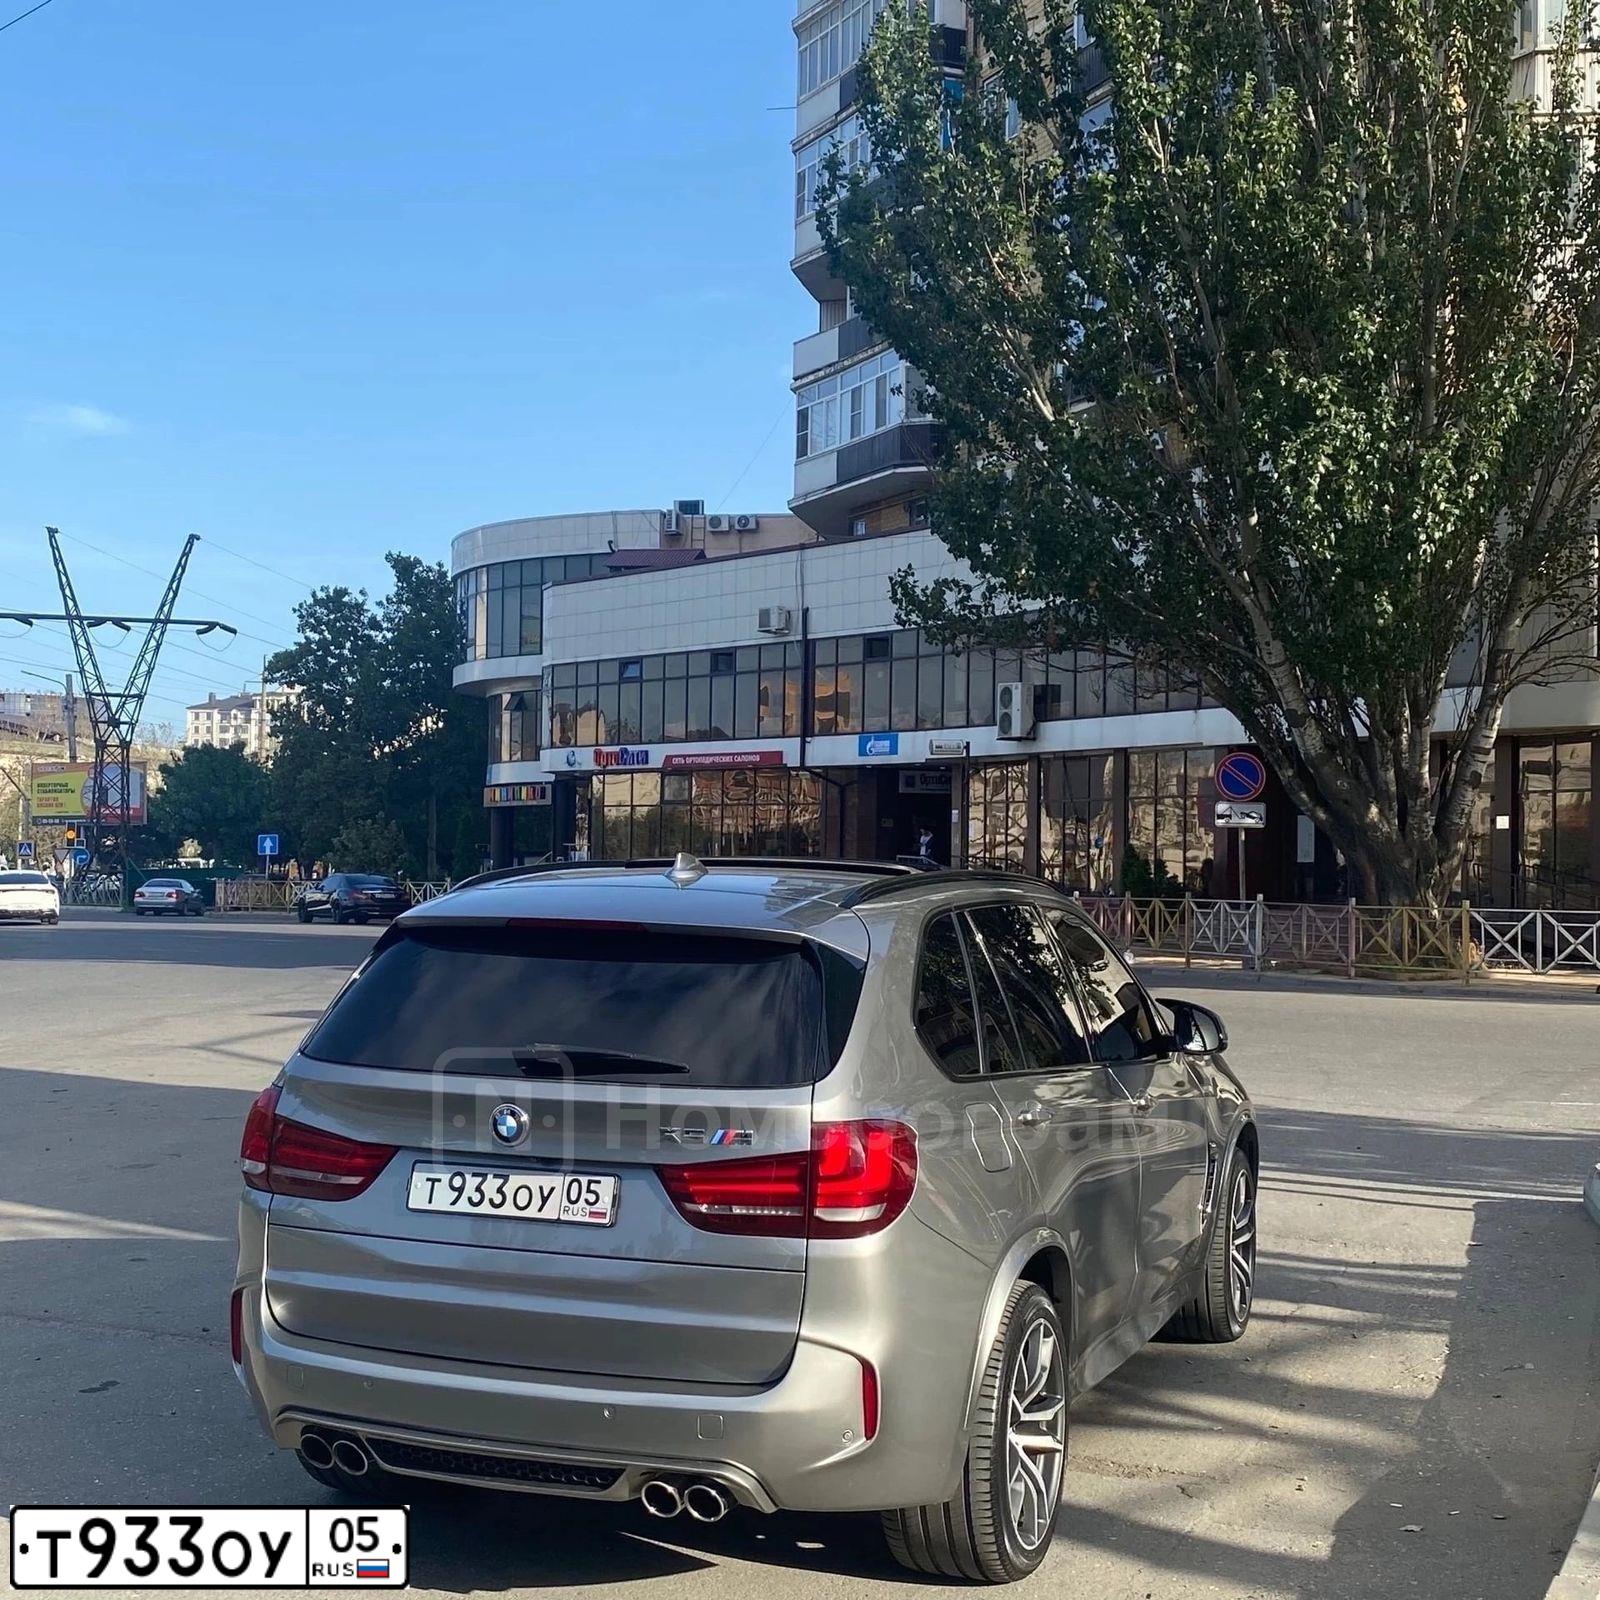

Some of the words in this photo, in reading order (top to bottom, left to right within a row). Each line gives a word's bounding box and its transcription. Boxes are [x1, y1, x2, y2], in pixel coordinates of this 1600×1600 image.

[672, 757, 685, 765] СЕТЬ
[686, 755, 733, 764] ОРТОПЕДИЧЕСКИХ
[734, 754, 760, 762] САЛОНОВ
[566, 1177, 602, 1206] 05
[562, 1205, 588, 1217] RUS
